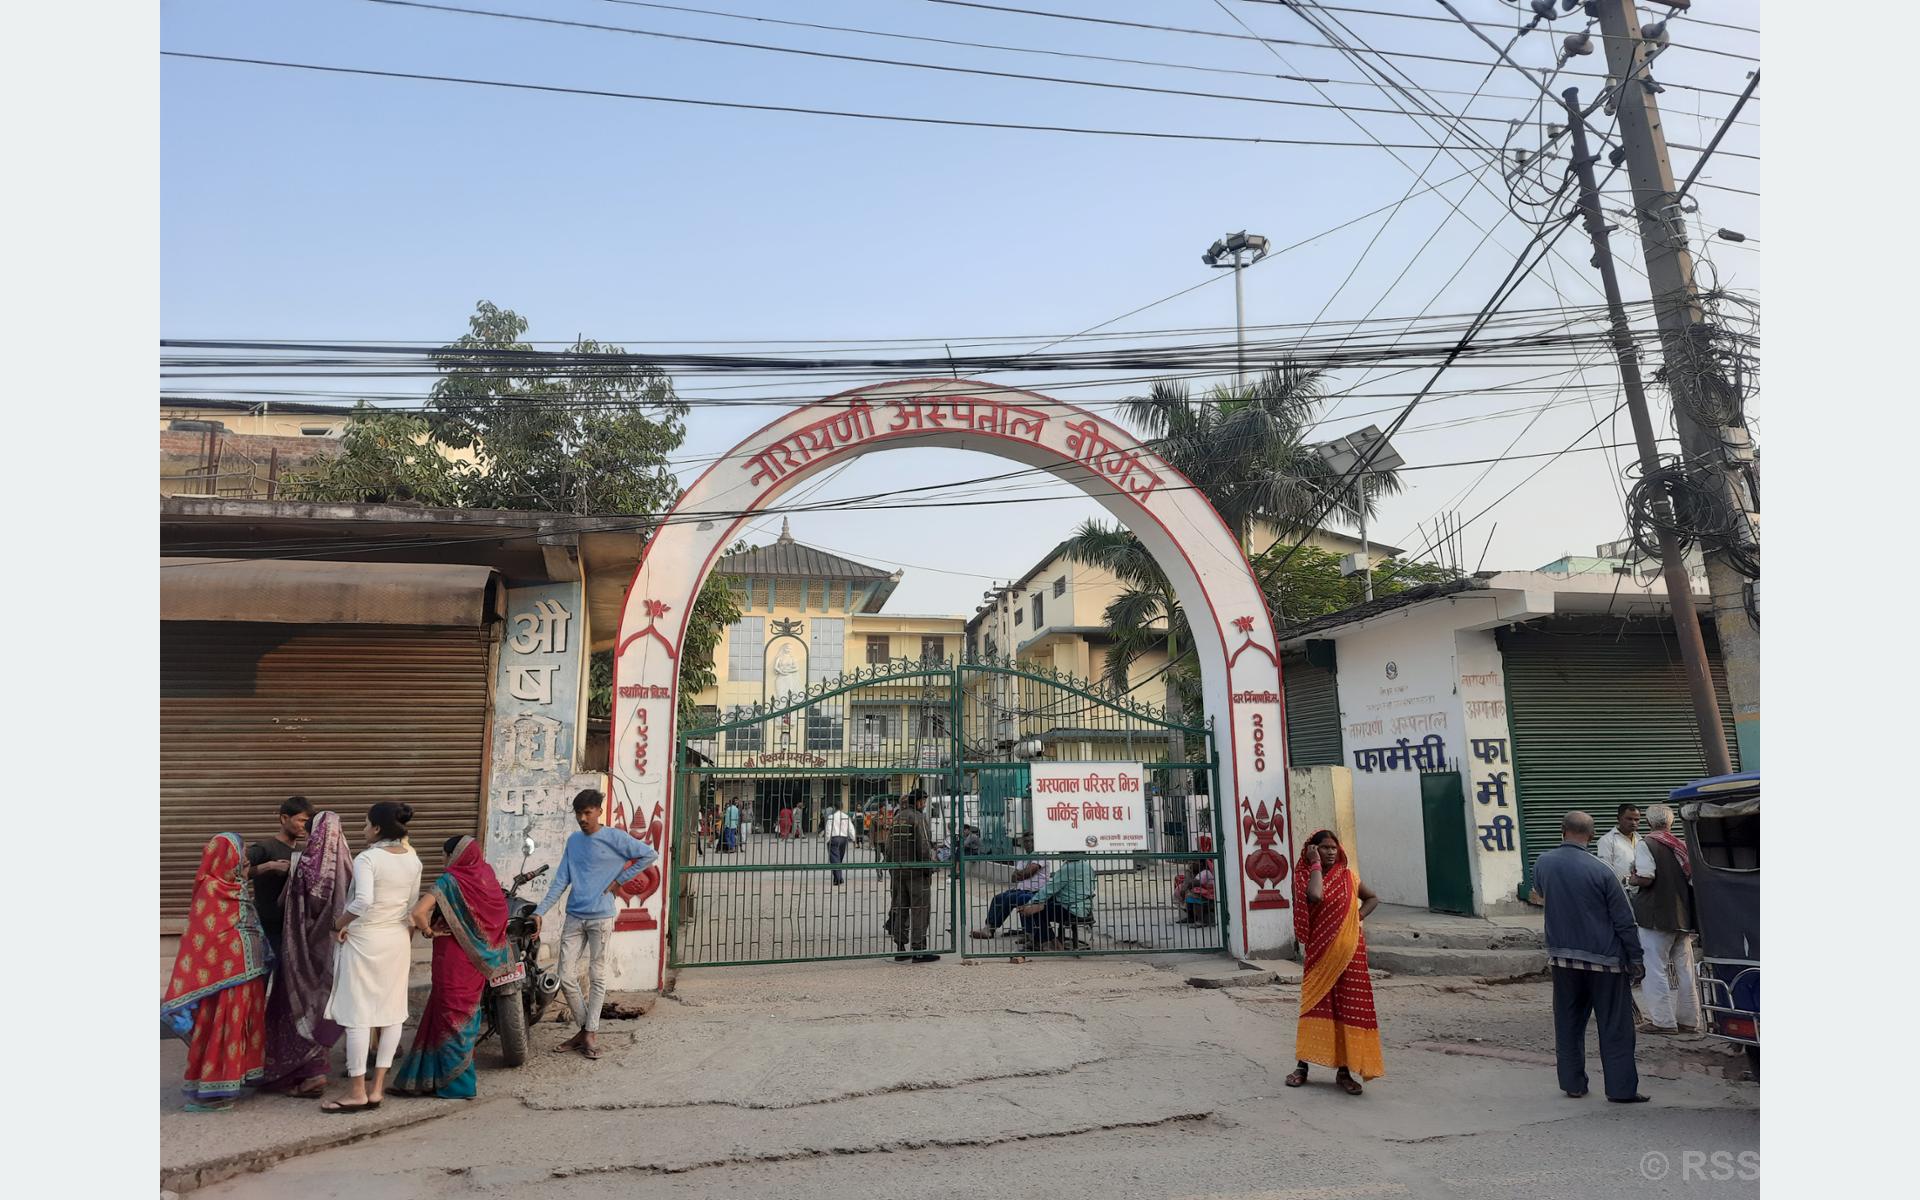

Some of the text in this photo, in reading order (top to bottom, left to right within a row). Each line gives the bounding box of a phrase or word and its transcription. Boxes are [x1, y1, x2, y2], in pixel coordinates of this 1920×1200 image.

[741, 396, 876, 487] नारायणी
[886, 396, 1051, 443] अस्पताल
[1253, 713, 1265, 773] २०६०
[1353, 734, 1447, 773] फार्मेसी
[1037, 772, 1140, 793] अस्पताल परिसर भित्र
[1113, 806, 1123, 821] छ
